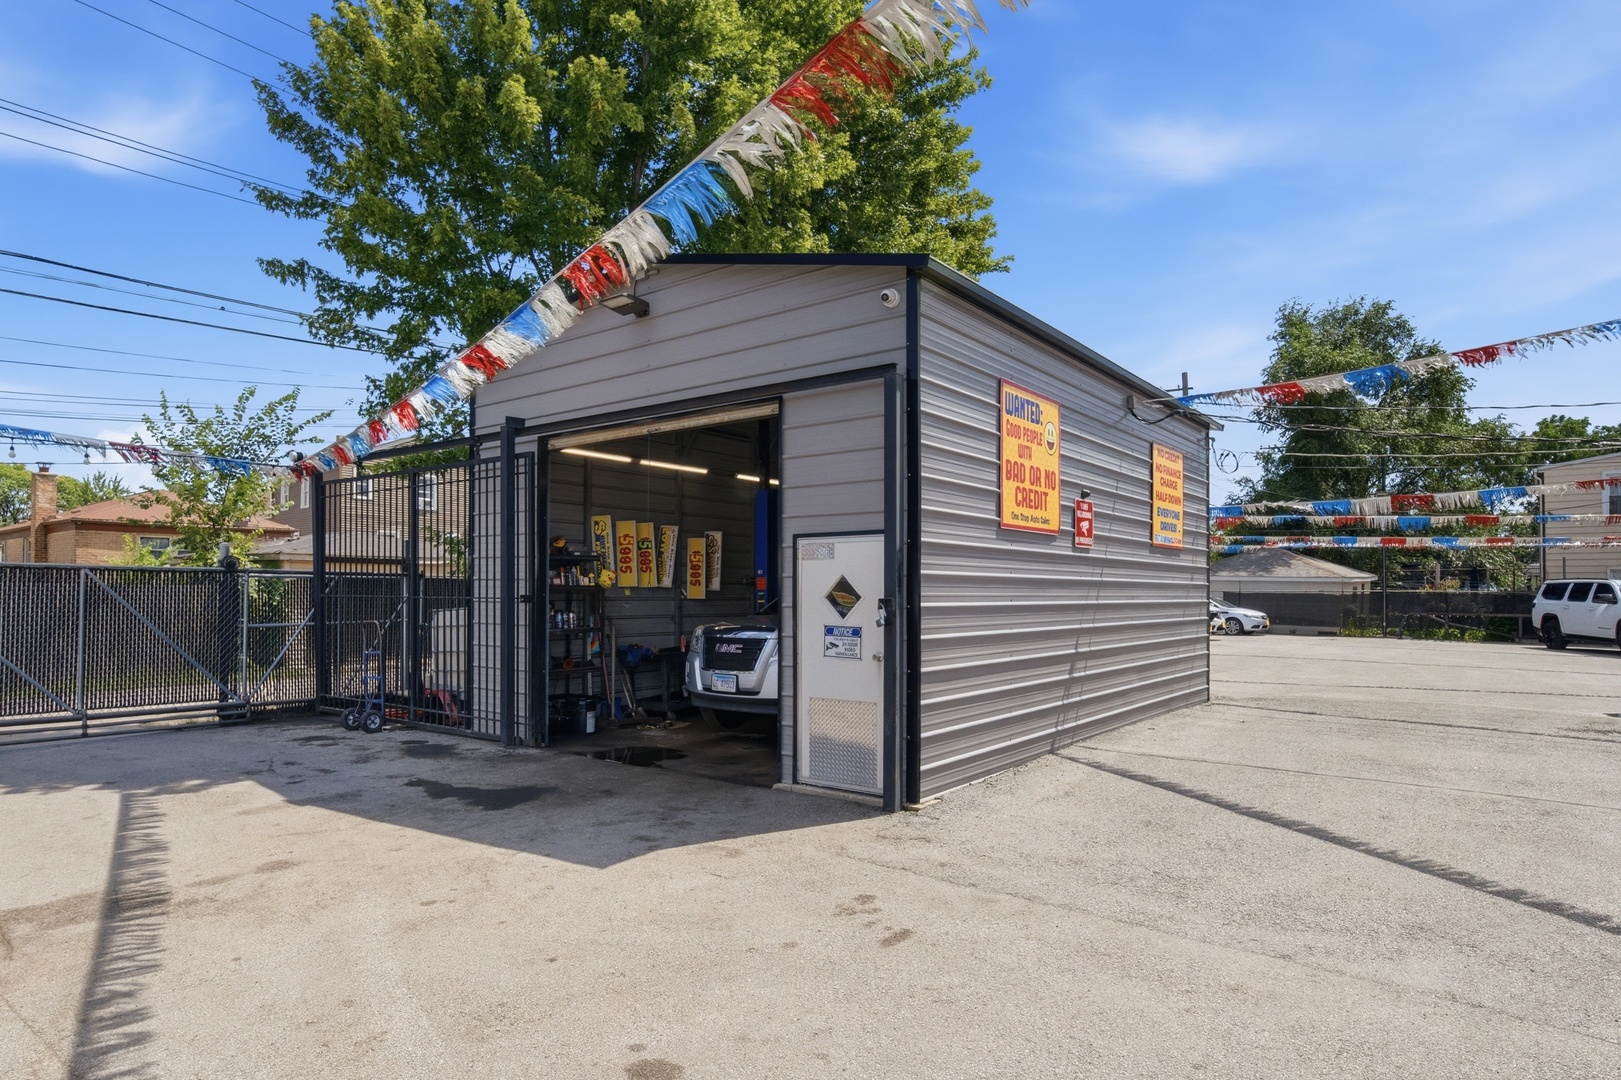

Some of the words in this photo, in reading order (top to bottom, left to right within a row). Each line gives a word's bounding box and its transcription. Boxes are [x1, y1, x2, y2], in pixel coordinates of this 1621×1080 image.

[1005, 391, 1043, 426] WANTED:
[1006, 418, 1021, 440] GOOD
[1022, 426, 1042, 447] PEOPLE
[1005, 459, 1025, 484] BAD
[1029, 465, 1042, 488] OR
[1044, 469, 1056, 491] NO
[1015, 485, 1048, 512] CREDIT
[833, 627, 853, 637] NOTICE
[715, 644, 743, 653] GMC
